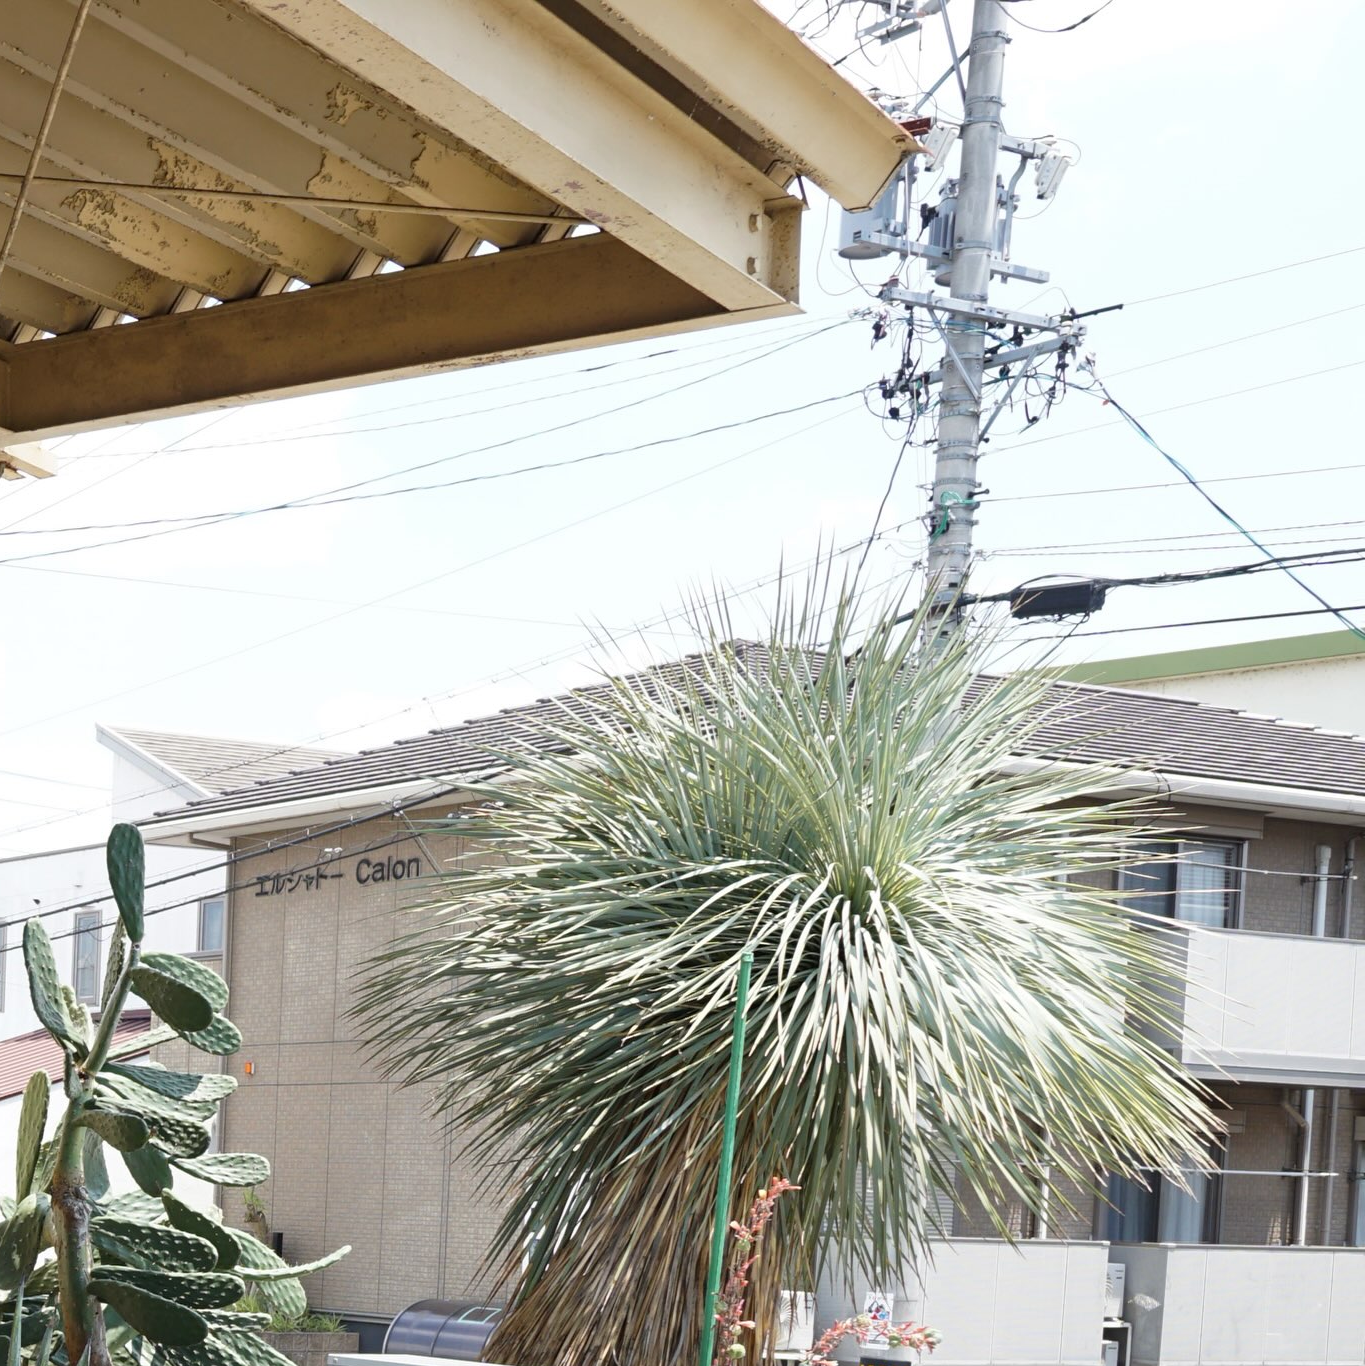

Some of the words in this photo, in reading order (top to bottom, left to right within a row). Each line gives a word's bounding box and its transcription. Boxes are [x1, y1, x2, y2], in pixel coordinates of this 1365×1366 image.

[255, 869, 343, 897] エルシャトー
[356, 857, 420, 884] Calon
